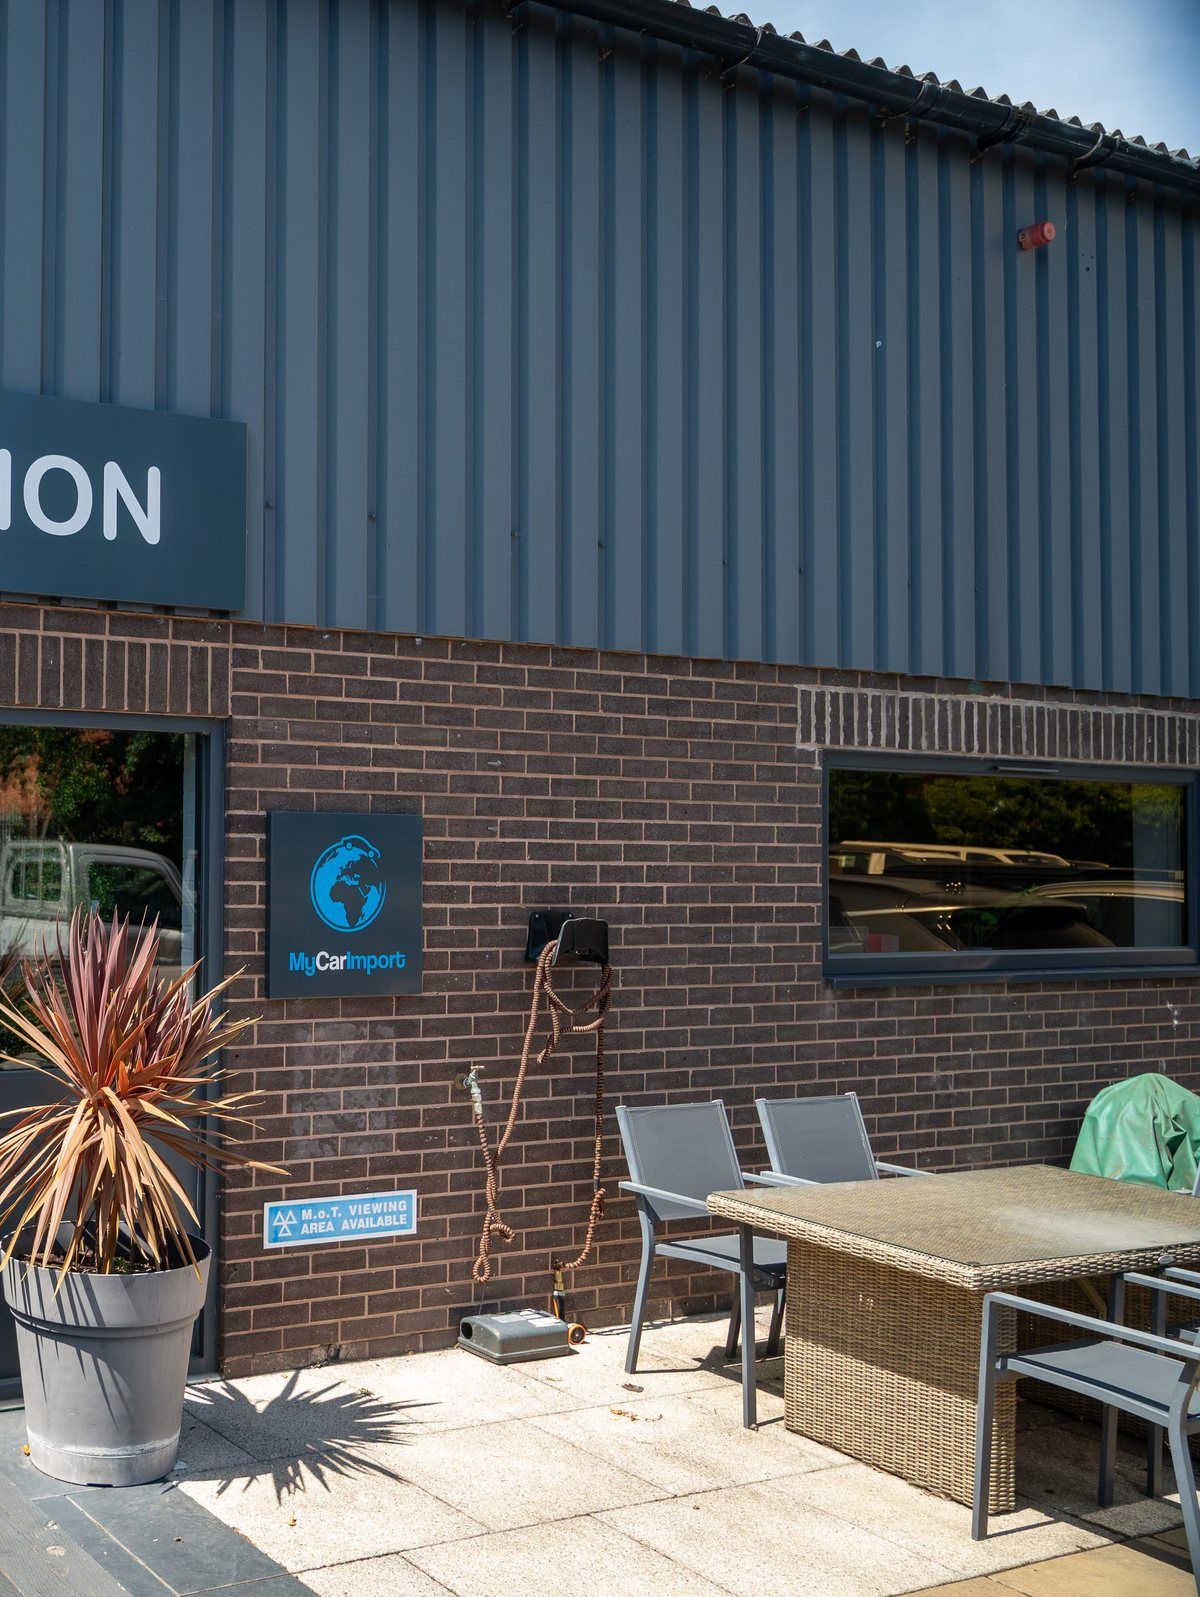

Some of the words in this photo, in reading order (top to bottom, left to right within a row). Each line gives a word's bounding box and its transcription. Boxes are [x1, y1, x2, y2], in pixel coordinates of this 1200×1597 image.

[301, 1206, 341, 1221] M.o.T.
[349, 1200, 407, 1217] VIEWING
[301, 1221, 334, 1235] AREA
[341, 1214, 407, 1231] AVAILABLE
